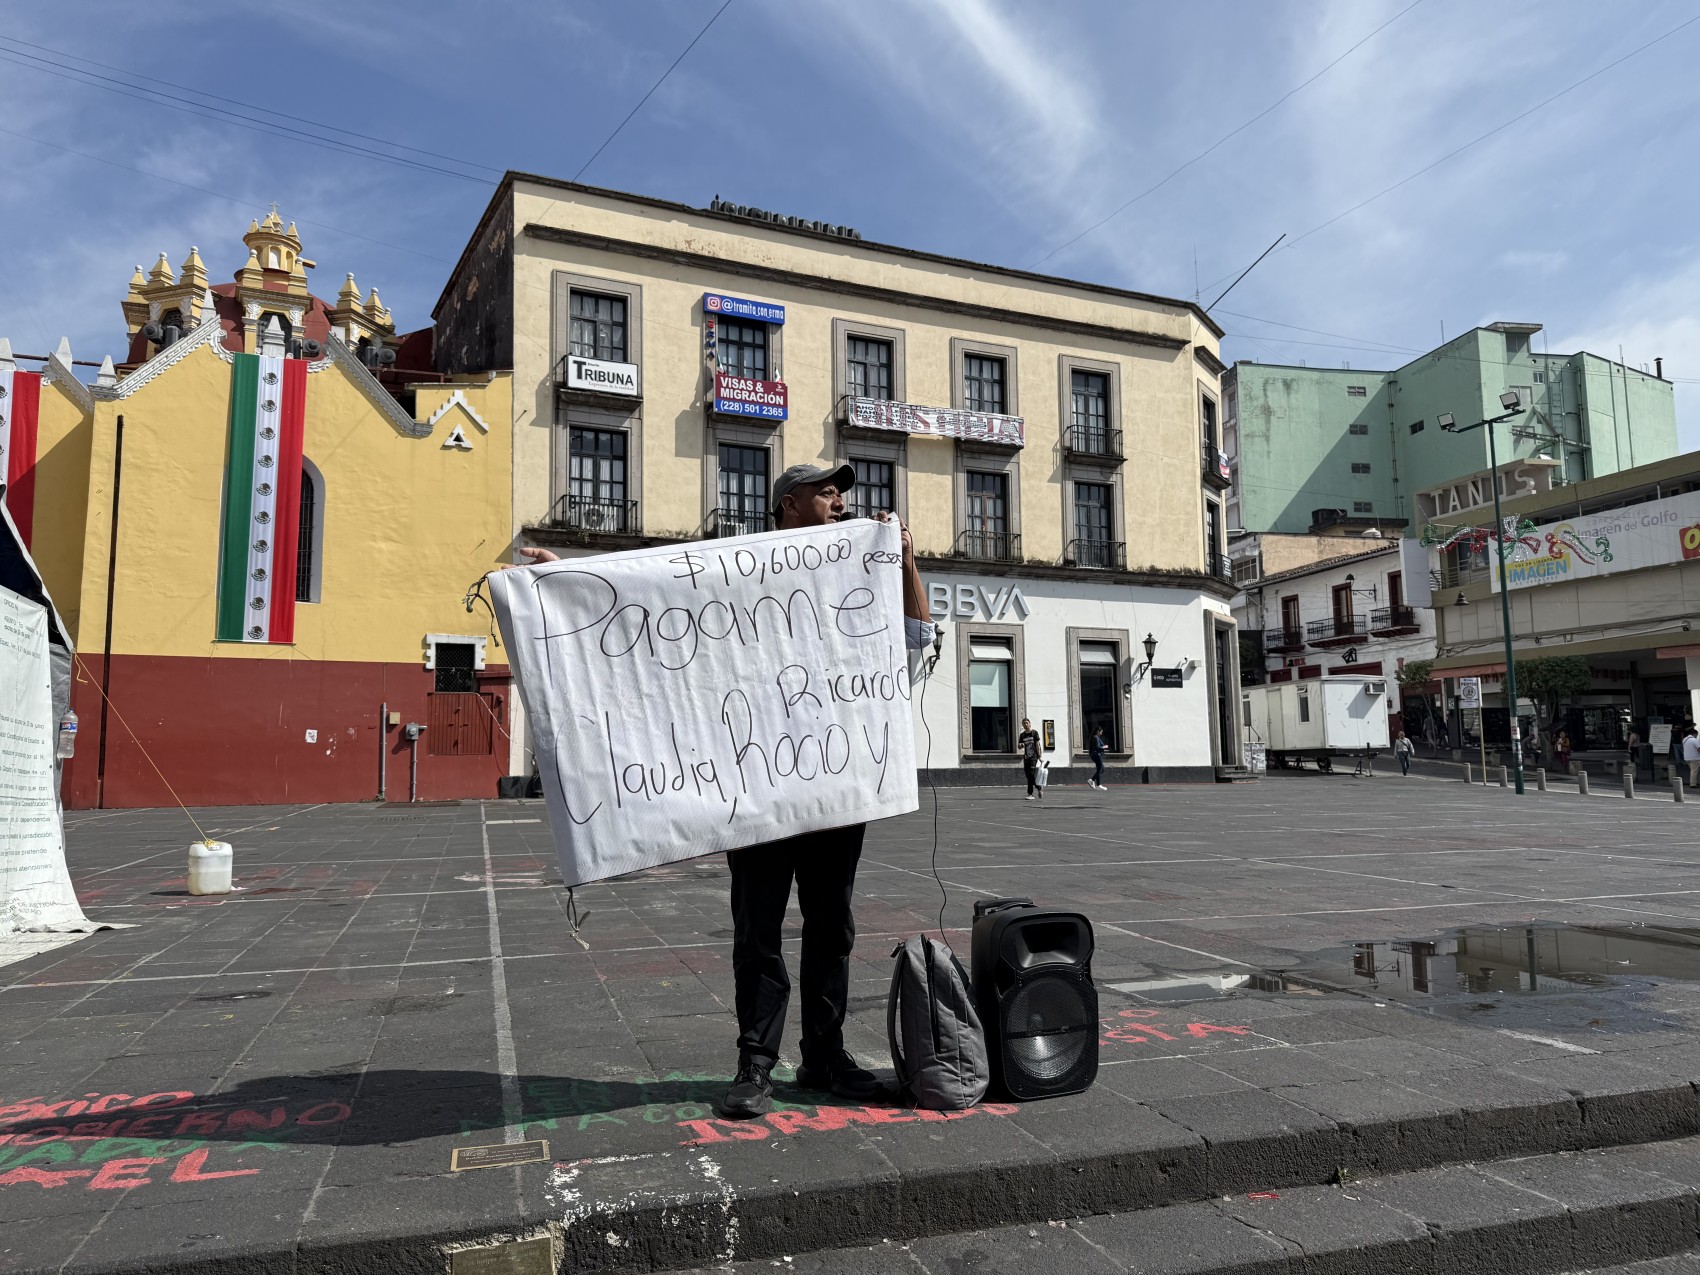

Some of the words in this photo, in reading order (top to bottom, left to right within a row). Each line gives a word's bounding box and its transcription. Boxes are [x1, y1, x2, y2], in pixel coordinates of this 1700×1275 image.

[572, 359, 634, 387] TRIBUNA
[720, 376, 754, 391] VISAS
[755, 381, 764, 393] &
[720, 387, 784, 406] MIGRACIÓN
[720, 399, 743, 414] (228)
[744, 403, 760, 414] 501
[762, 405, 783, 417] 2365
[1577, 523, 1621, 540] Imagen
[1624, 521, 1638, 532] del
[1641, 510, 1678, 527] Golfo
[669, 538, 852, 590] $10,600.00
[1509, 560, 1567, 583] IMAGEN
[928, 582, 1030, 618] BBVA
[531, 570, 890, 689] Pagame
[777, 645, 911, 719] Ricardo
